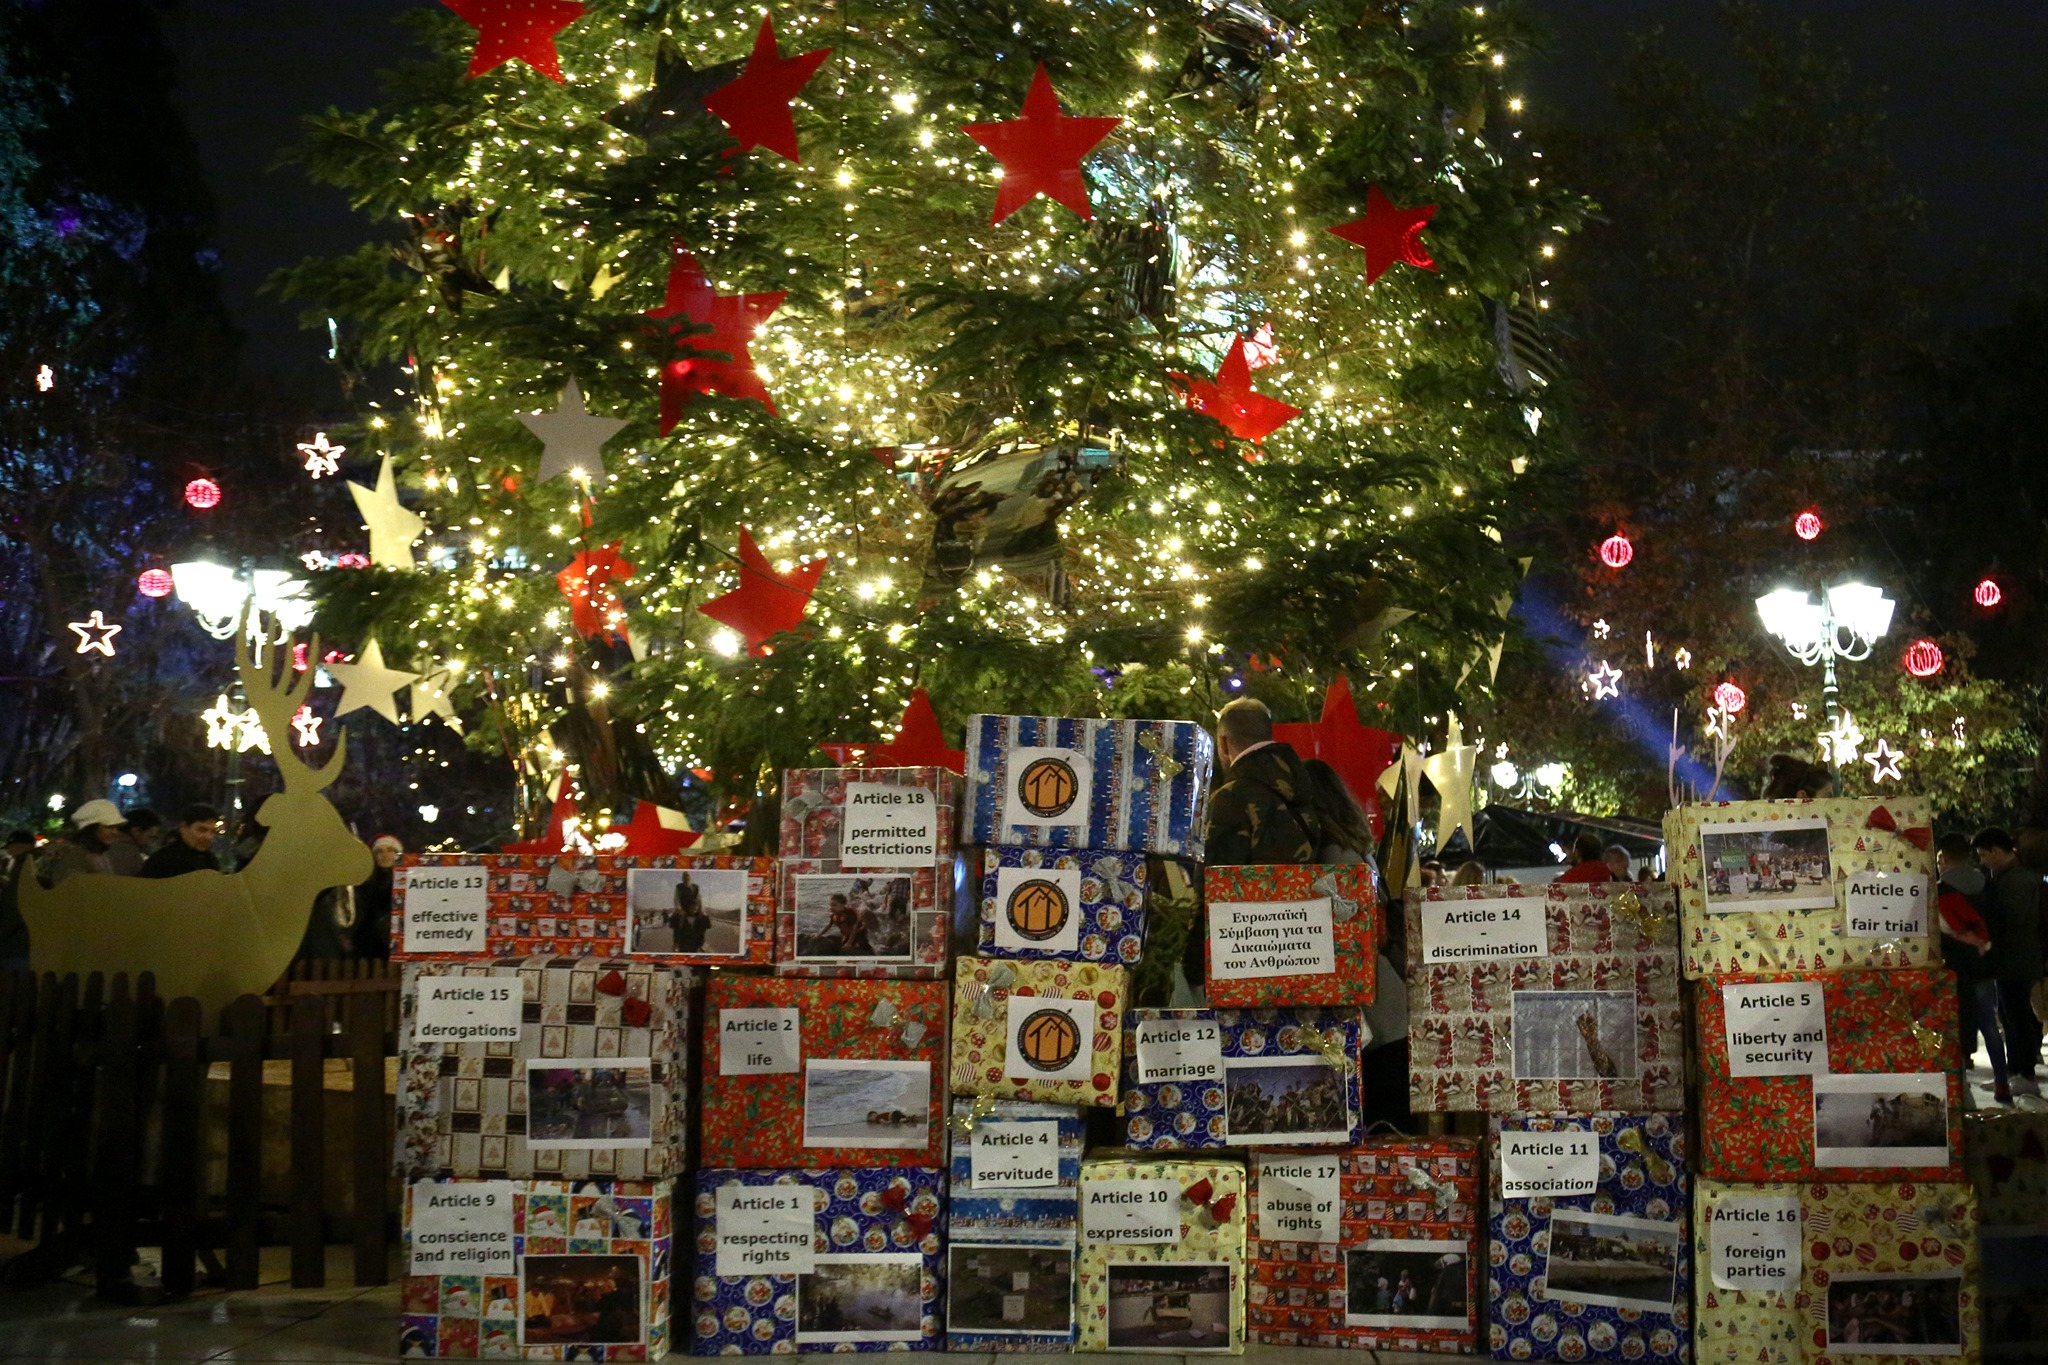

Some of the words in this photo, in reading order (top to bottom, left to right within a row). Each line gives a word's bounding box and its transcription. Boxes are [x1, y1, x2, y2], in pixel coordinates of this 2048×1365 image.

[852, 792, 901, 805] Article
[907, 792, 925, 804] 18
[851, 825, 926, 841] permitted
[844, 842, 933, 855] restrictions
[408, 877, 459, 890] Article
[464, 876, 483, 889] 13
[1850, 883, 1904, 897] Article
[1909, 884, 1920, 898] 6
[411, 910, 479, 923] effective
[1232, 908, 1308, 925] Ευρωπαϊκή
[1444, 910, 1496, 924] Article
[1502, 908, 1521, 921] 14
[1851, 917, 1881, 932] fair
[1884, 919, 1919, 933] trial
[415, 927, 474, 942] remedy
[1218, 926, 1279, 941] Σύμβαση
[1282, 926, 1304, 939] για
[1306, 925, 1323, 935] τα
[1231, 939, 1312, 954] Δικαιώματα
[1431, 942, 1538, 958] discrimination
[1223, 960, 1247, 970] του
[1249, 954, 1320, 970] Ανθρώπου
[431, 988, 485, 1001] Article
[490, 988, 509, 1001] 15
[1740, 994, 1795, 1009] Article
[1800, 993, 1811, 1006] 5
[421, 1023, 517, 1039] derogations
[725, 1019, 778, 1032] Article
[783, 1019, 793, 1031] 2
[1140, 1029, 1191, 1044] Article
[1196, 1027, 1216, 1041] 12
[1732, 1031, 1787, 1047] liberty
[1792, 1028, 1824, 1043] and
[747, 1053, 772, 1066] life
[1745, 1048, 1813, 1064] security
[1145, 1063, 1216, 1078] marriage
[981, 1132, 1034, 1146] Article
[1038, 1132, 1049, 1145] 4
[1510, 1142, 1564, 1156] Article
[1570, 1143, 1589, 1156] 11
[978, 1167, 1054, 1181] servitude
[1261, 1165, 1312, 1178] Article
[1317, 1166, 1336, 1179] 17
[1505, 1178, 1594, 1191] association
[428, 1194, 481, 1208] Article
[485, 1194, 496, 1207] 9
[731, 1197, 785, 1210] Article
[791, 1197, 800, 1209] 1
[1090, 1191, 1143, 1204] Article
[1148, 1190, 1168, 1203] 10
[1266, 1198, 1312, 1213] abuse
[1316, 1200, 1333, 1213] of
[1714, 1208, 1770, 1222] Article
[1776, 1209, 1797, 1223] 16
[1277, 1216, 1322, 1231] rights
[418, 1230, 507, 1244] conscience
[722, 1231, 809, 1247] respecting
[1086, 1225, 1173, 1242] expression
[414, 1248, 445, 1263] and
[450, 1247, 511, 1264] religion
[742, 1249, 790, 1265] rights
[1724, 1245, 1786, 1262] foreign
[1726, 1264, 1786, 1279] parties
